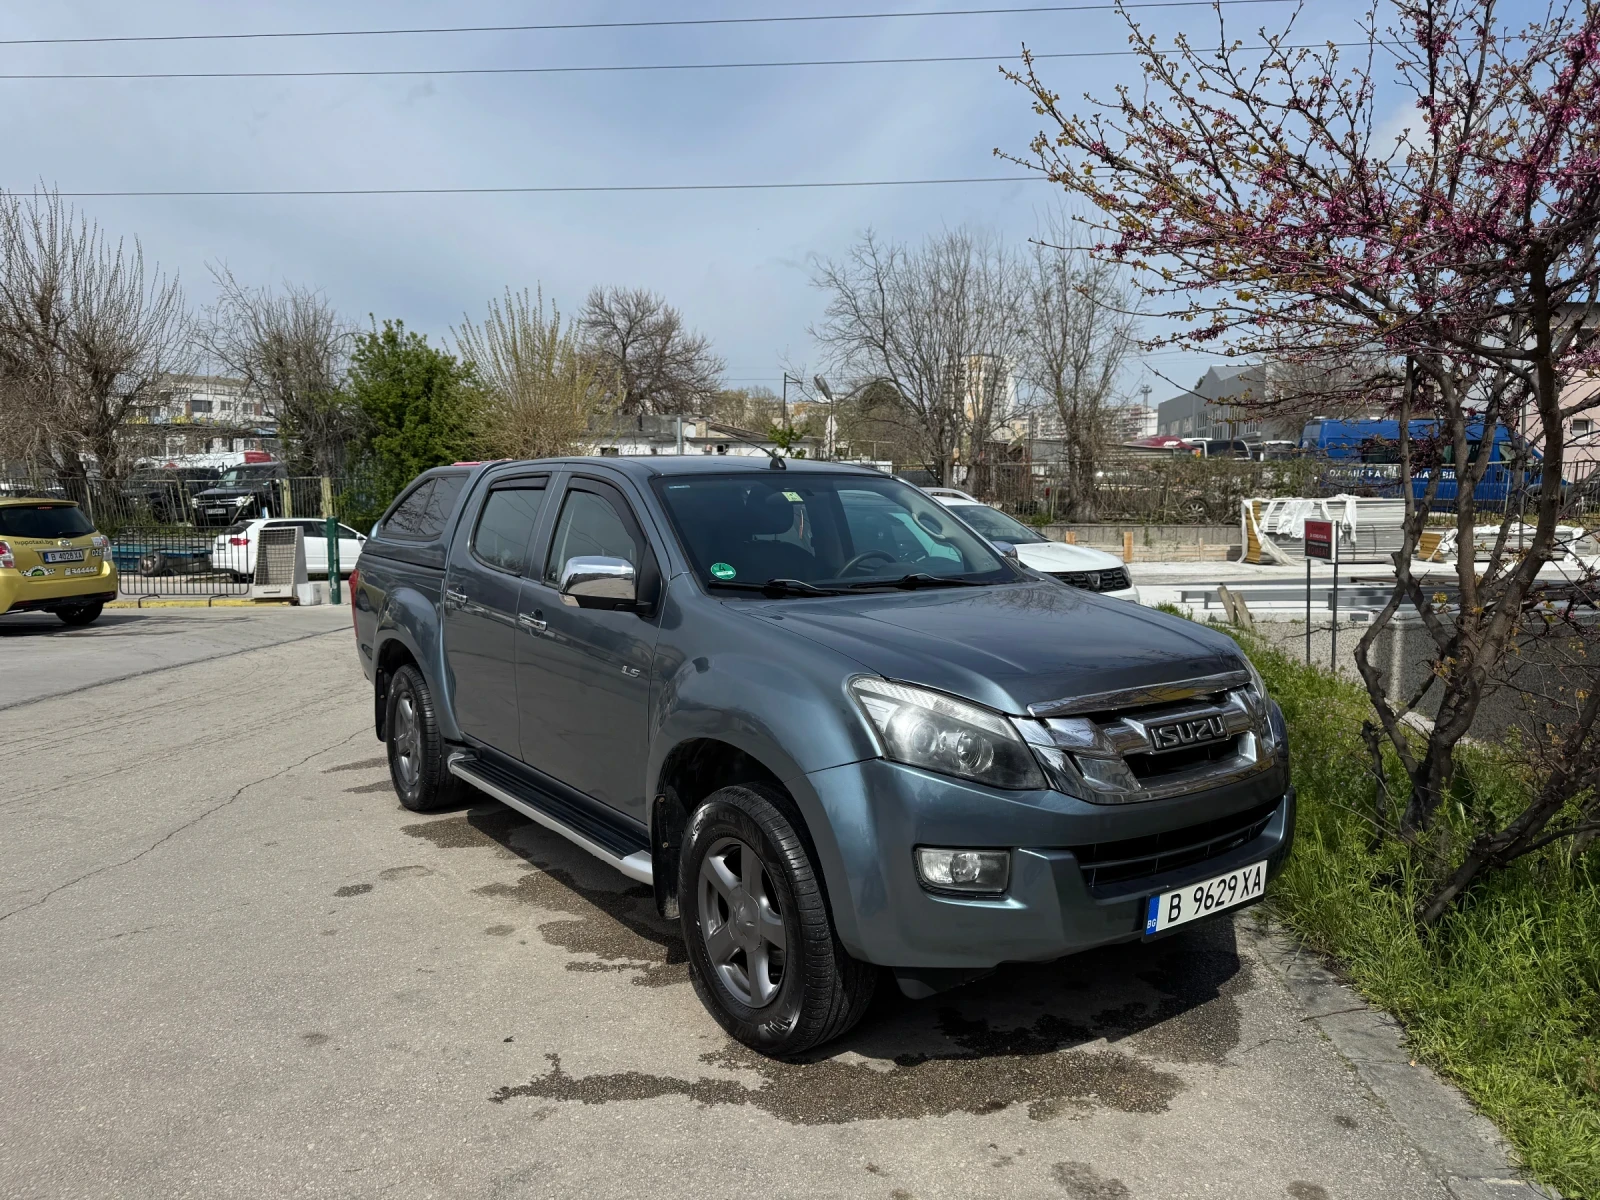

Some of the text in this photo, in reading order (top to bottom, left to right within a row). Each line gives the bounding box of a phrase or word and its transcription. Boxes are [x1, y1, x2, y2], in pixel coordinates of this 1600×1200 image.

[620, 665, 641, 678] LS
[1150, 714, 1226, 750] ISUZU
[1167, 865, 1262, 924] B 9629 XA
[1147, 917, 1157, 929] BG
